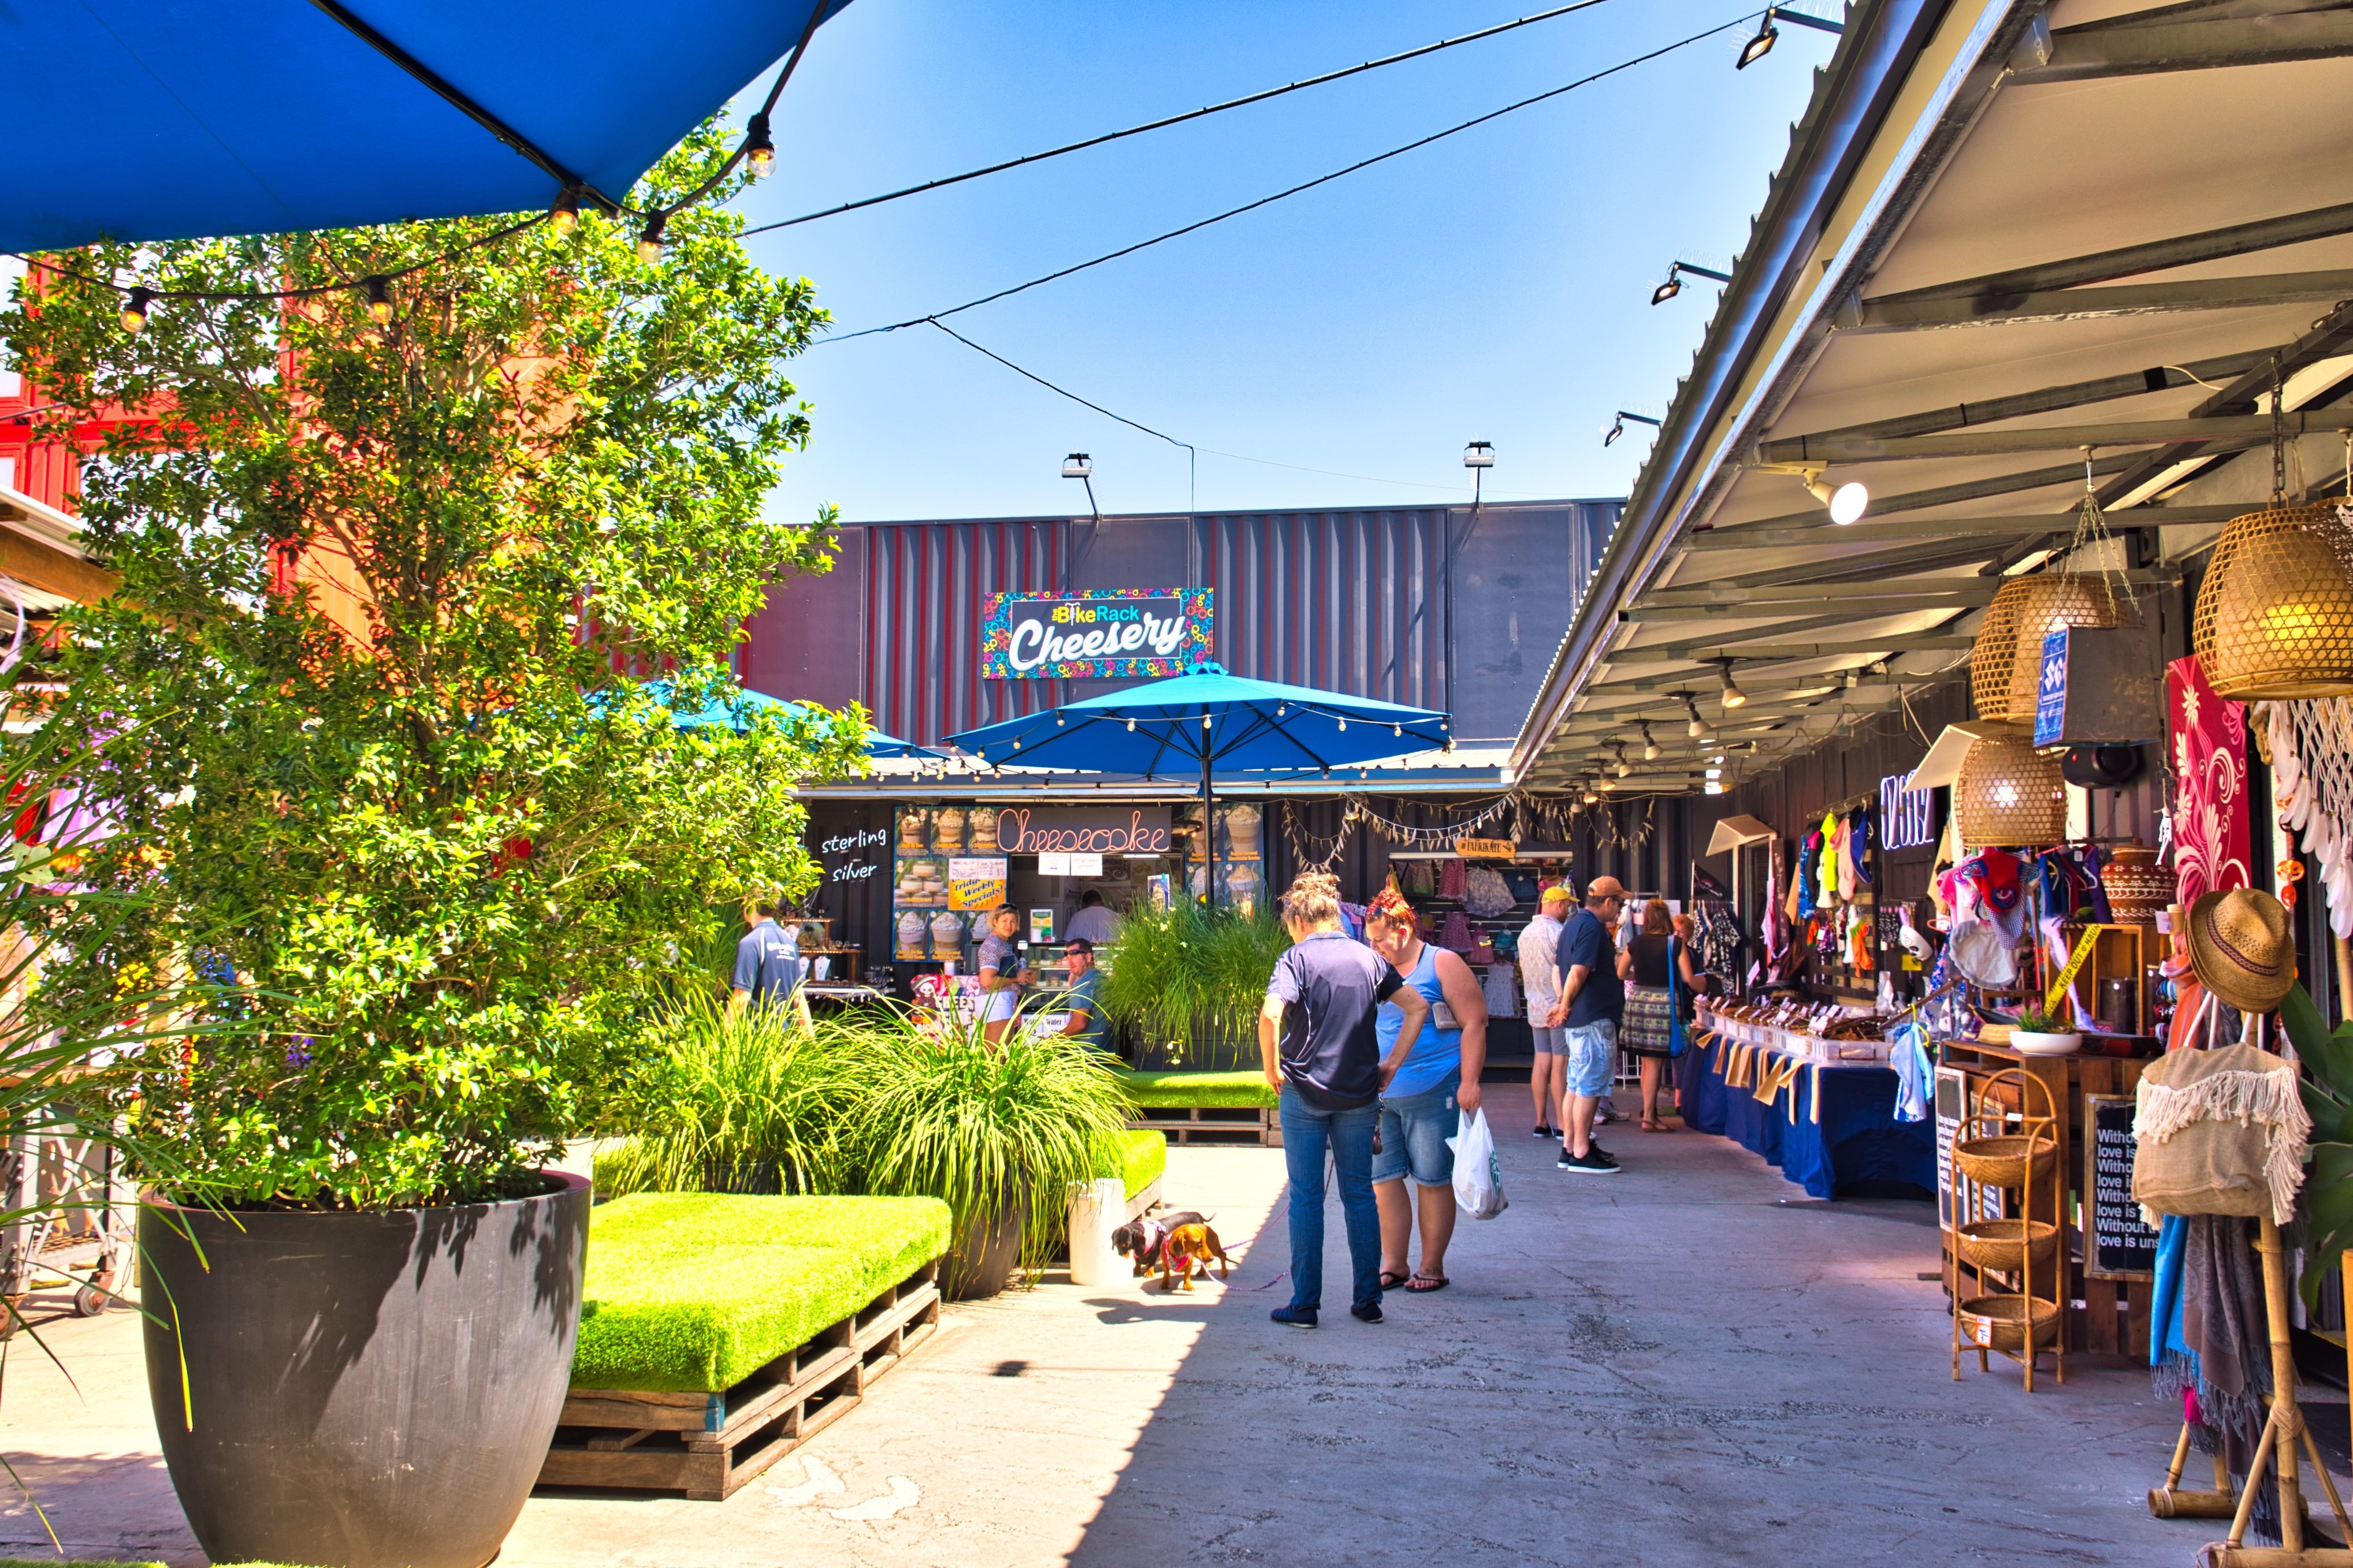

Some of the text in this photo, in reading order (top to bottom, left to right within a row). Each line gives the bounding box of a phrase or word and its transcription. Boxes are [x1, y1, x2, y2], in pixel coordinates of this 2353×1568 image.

[1096, 605, 1139, 621] Rack
[1009, 612, 1187, 671] Cheesery
[997, 809, 1169, 852] Cheesecake
[822, 829, 886, 853] sterling
[832, 862, 877, 881] silver
[964, 880, 995, 897] Weekly
[2084, 924, 2102, 946] HAUN
[2059, 953, 2084, 989] KEEP OUT
[2098, 1129, 2138, 1143] Witho
[2098, 1144, 2136, 1159] love is
[2097, 1159, 2133, 1173] Witho
[2098, 1173, 2122, 1187] love
[2096, 1188, 2132, 1202] Witho
[2097, 1203, 2136, 1218] love is
[2096, 1217, 2146, 1233] Without
[2097, 1232, 2159, 1248] love is uns
